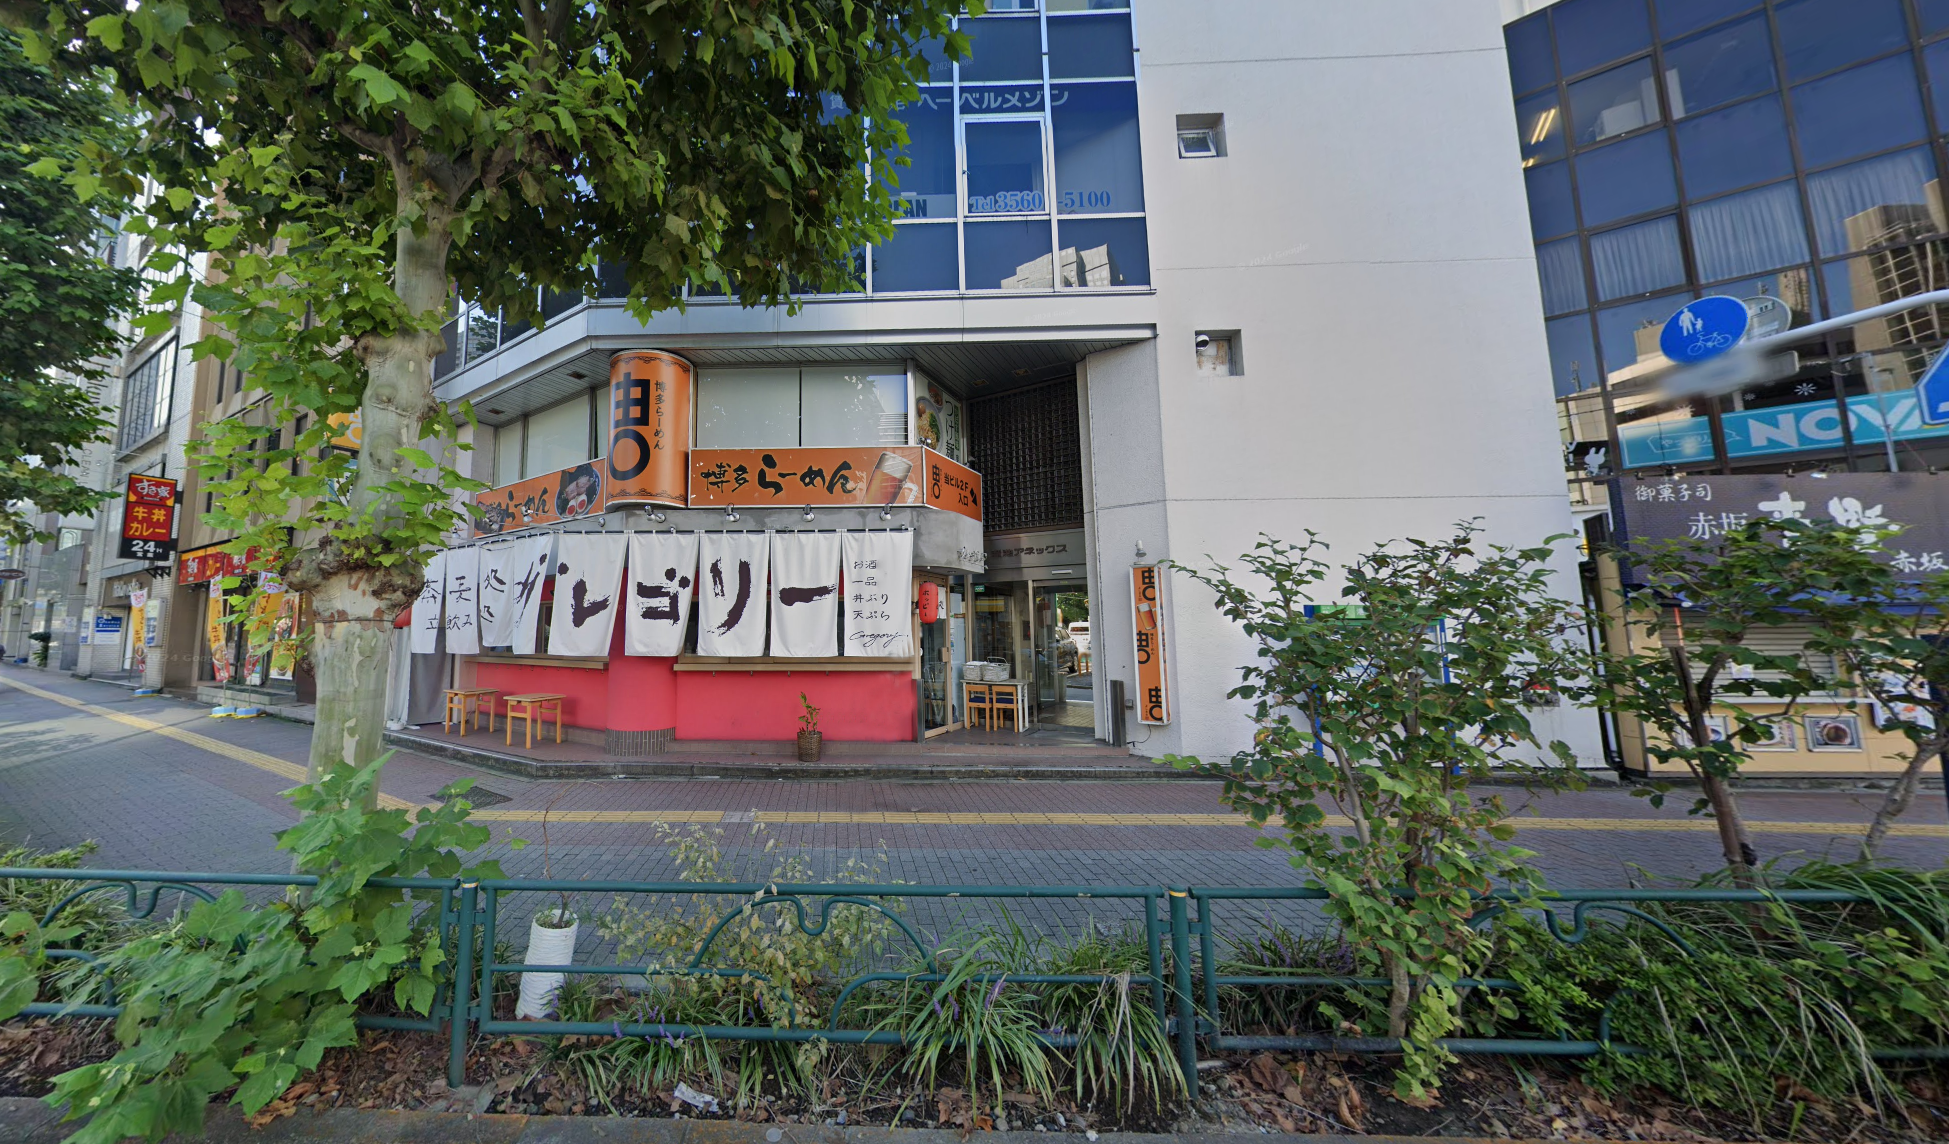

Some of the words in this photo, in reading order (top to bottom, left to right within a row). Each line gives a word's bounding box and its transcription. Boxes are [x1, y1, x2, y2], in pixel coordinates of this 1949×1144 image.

[970, 195, 995, 211] Tel
[997, 191, 1043, 211] 3560
[653, 380, 668, 450] 博多らーめん
[701, 454, 859, 497] 博多らーめん
[944, 472, 968, 492] 当ビル2F
[135, 479, 170, 498] すき家
[1635, 483, 1712, 502] 御菓子司
[958, 493, 969, 507] 入口
[133, 506, 166, 522] 牛丼
[129, 522, 166, 536] カレー
[853, 560, 878, 570] お酒
[852, 576, 877, 587] 一品
[853, 610, 890, 622] 天ぷら
